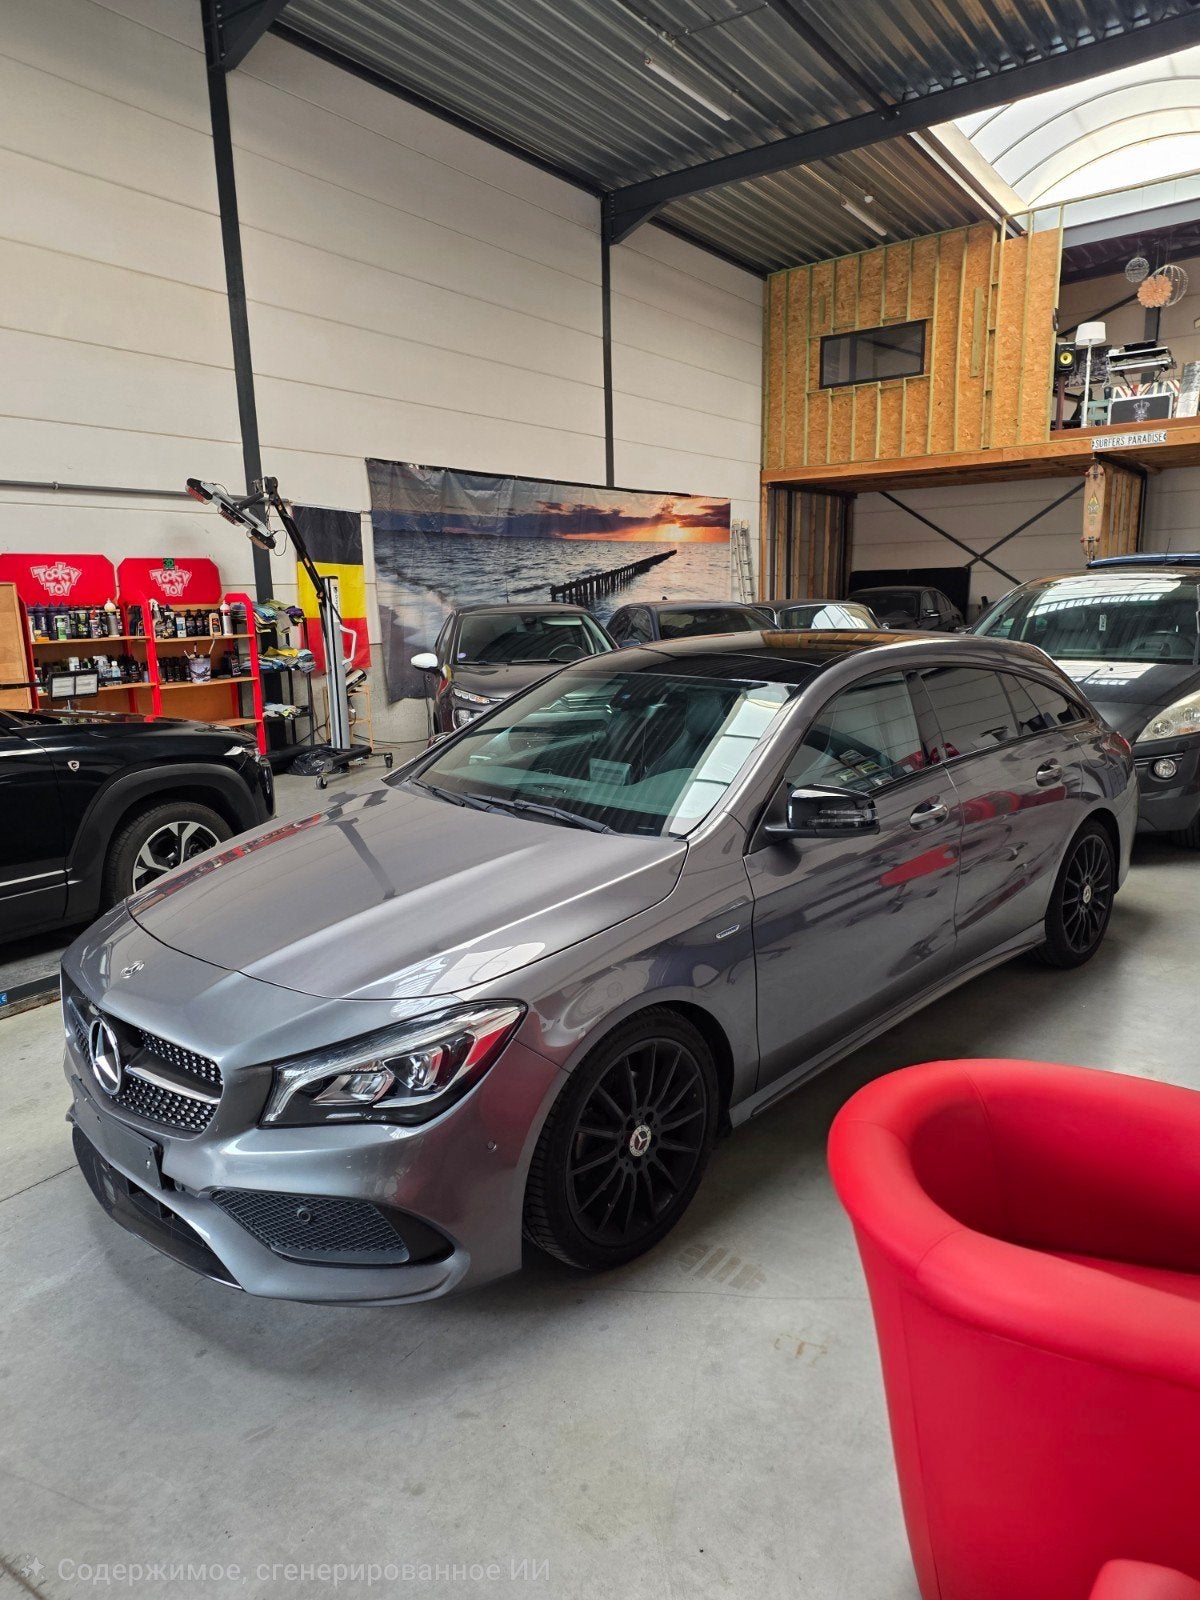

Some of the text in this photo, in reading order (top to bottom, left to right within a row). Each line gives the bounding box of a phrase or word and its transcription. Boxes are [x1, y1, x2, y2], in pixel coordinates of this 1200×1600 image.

[1095, 432, 1163, 448] SURFERS PARADISE
[44, 581, 71, 596] TOY
[161, 583, 185, 596] TOY
